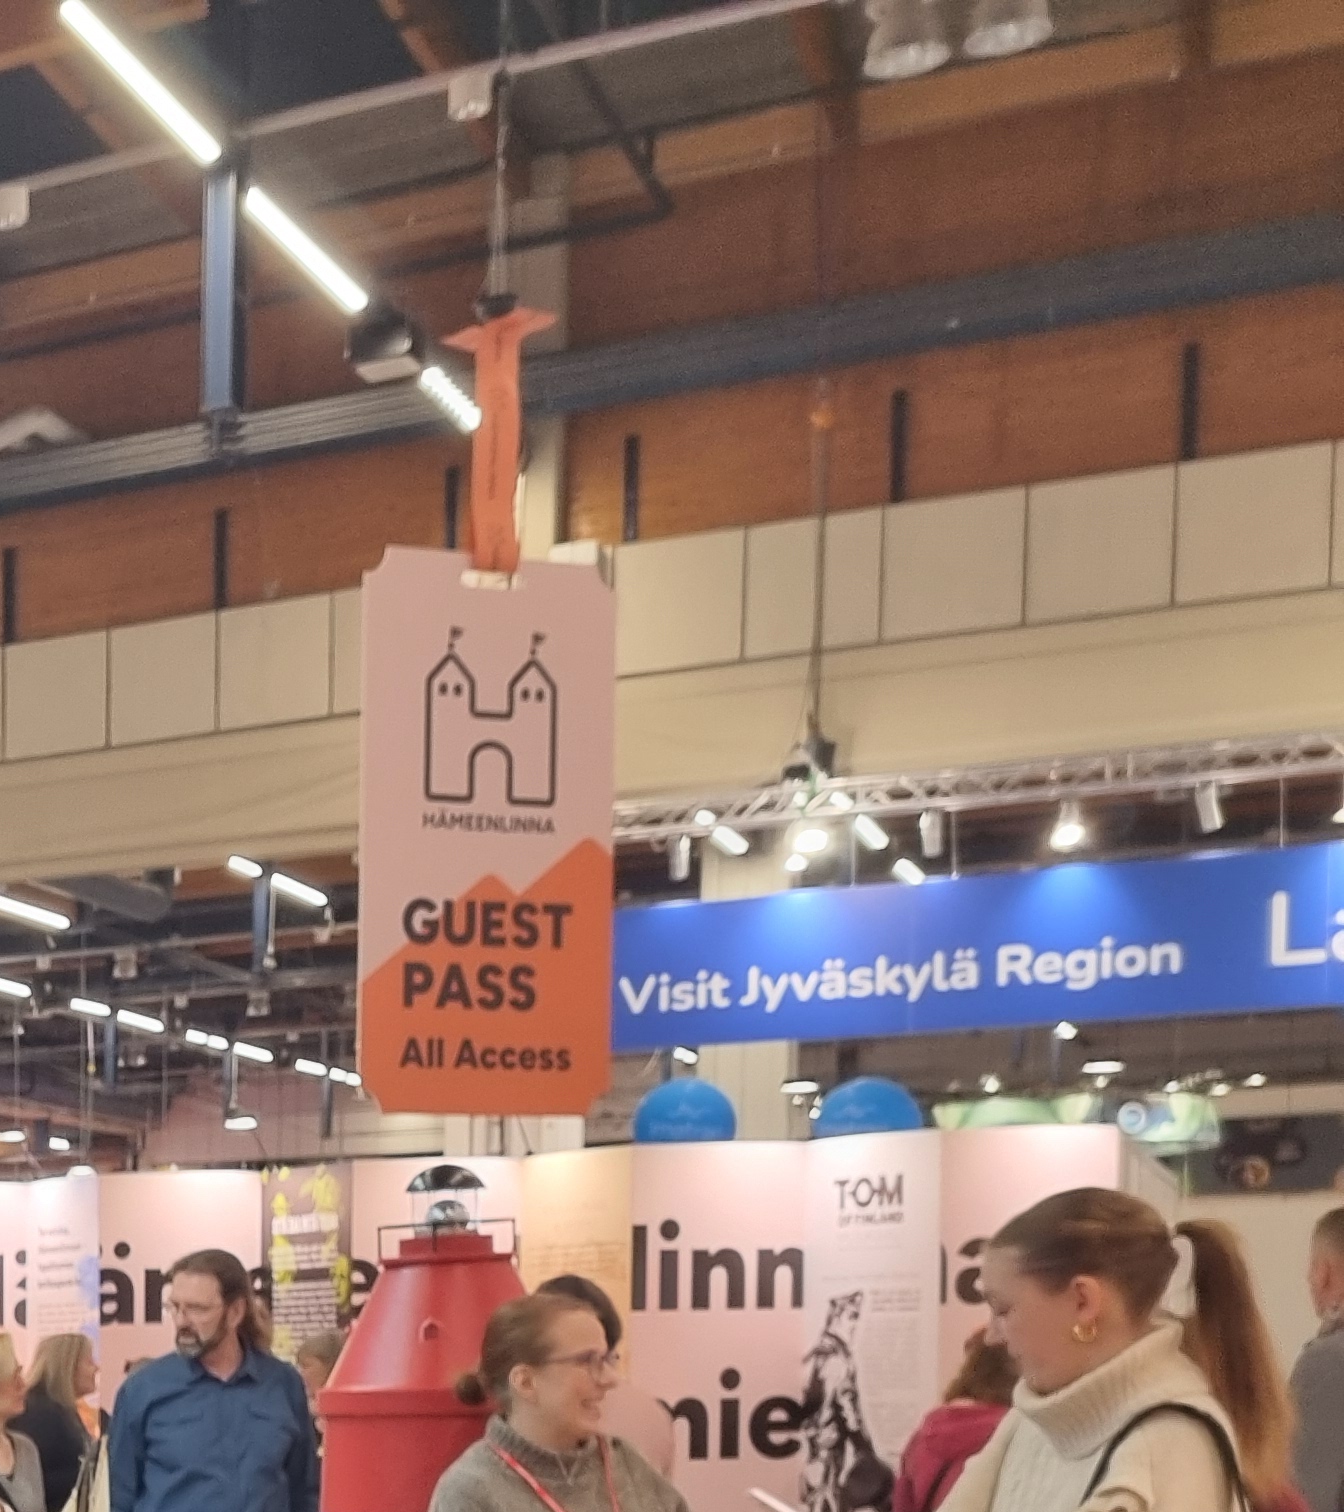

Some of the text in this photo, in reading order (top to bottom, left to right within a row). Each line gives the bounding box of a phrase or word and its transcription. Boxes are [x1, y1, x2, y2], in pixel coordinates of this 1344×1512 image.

[422, 811, 556, 834] HÄMEENLINNA
[402, 898, 572, 950] GUEST
[403, 961, 536, 1011] PASS
[619, 936, 1182, 1014] Visit Jyväskylä Region
[400, 1037, 572, 1071] All Access
